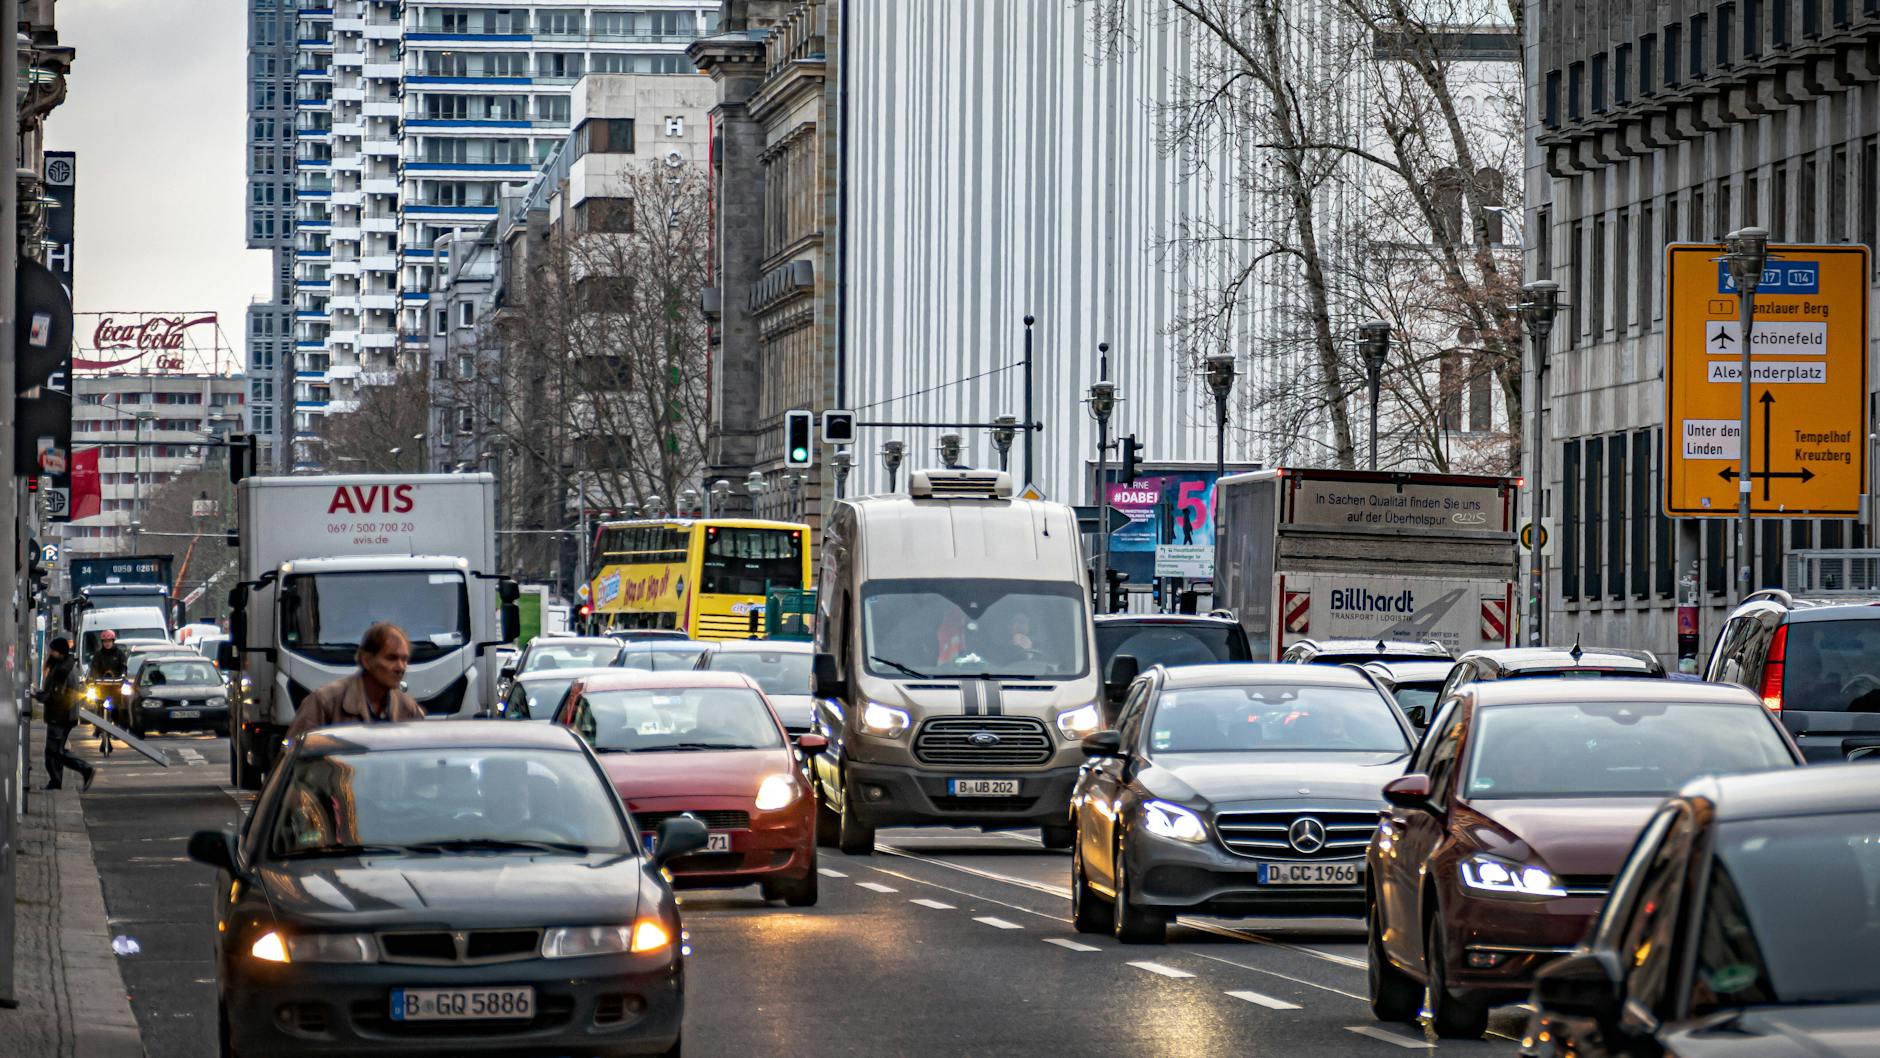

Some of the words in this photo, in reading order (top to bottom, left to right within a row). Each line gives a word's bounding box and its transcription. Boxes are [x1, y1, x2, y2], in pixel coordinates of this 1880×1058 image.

[1794, 272, 1809, 283] 114
[1753, 302, 1800, 314] enzlauer
[1804, 302, 1829, 317] Berg
[1751, 331, 1823, 345] chönefeld
[1713, 366, 1822, 381] Alexnderplatz
[1687, 424, 1717, 437] Unter
[1721, 425, 1740, 437] den
[1795, 430, 1852, 445] Tempelhof
[1687, 443, 1723, 455] Linden
[1795, 449, 1851, 464] Kreuzberg
[1123, 481, 1149, 489] VRNE
[327, 484, 414, 513] AVIS
[1114, 492, 1157, 503] #DABEI
[1316, 494, 1325, 504] In
[1328, 494, 1366, 506] Sachen
[1369, 495, 1407, 507] Qualität
[1410, 496, 1441, 509] finden
[1443, 498, 1460, 509] Sie
[1462, 500, 1481, 511] uns
[1347, 511, 1363, 522] auf
[1366, 512, 1382, 523] der
[327, 523, 346, 533] 069
[356, 523, 376, 533] 500
[379, 523, 398, 532] 700
[400, 522, 414, 532] 20
[353, 534, 389, 544] avis.de
[1331, 588, 1414, 613] Billhardt
[960, 782, 967, 792] B
[975, 782, 990, 793] UB
[992, 782, 1013, 793] 202
[708, 836, 727, 849] 71
[1269, 866, 1279, 880] D
[406, 994, 419, 1015] B
[436, 994, 466, 1015] GQ
[472, 992, 529, 1014] 5886
